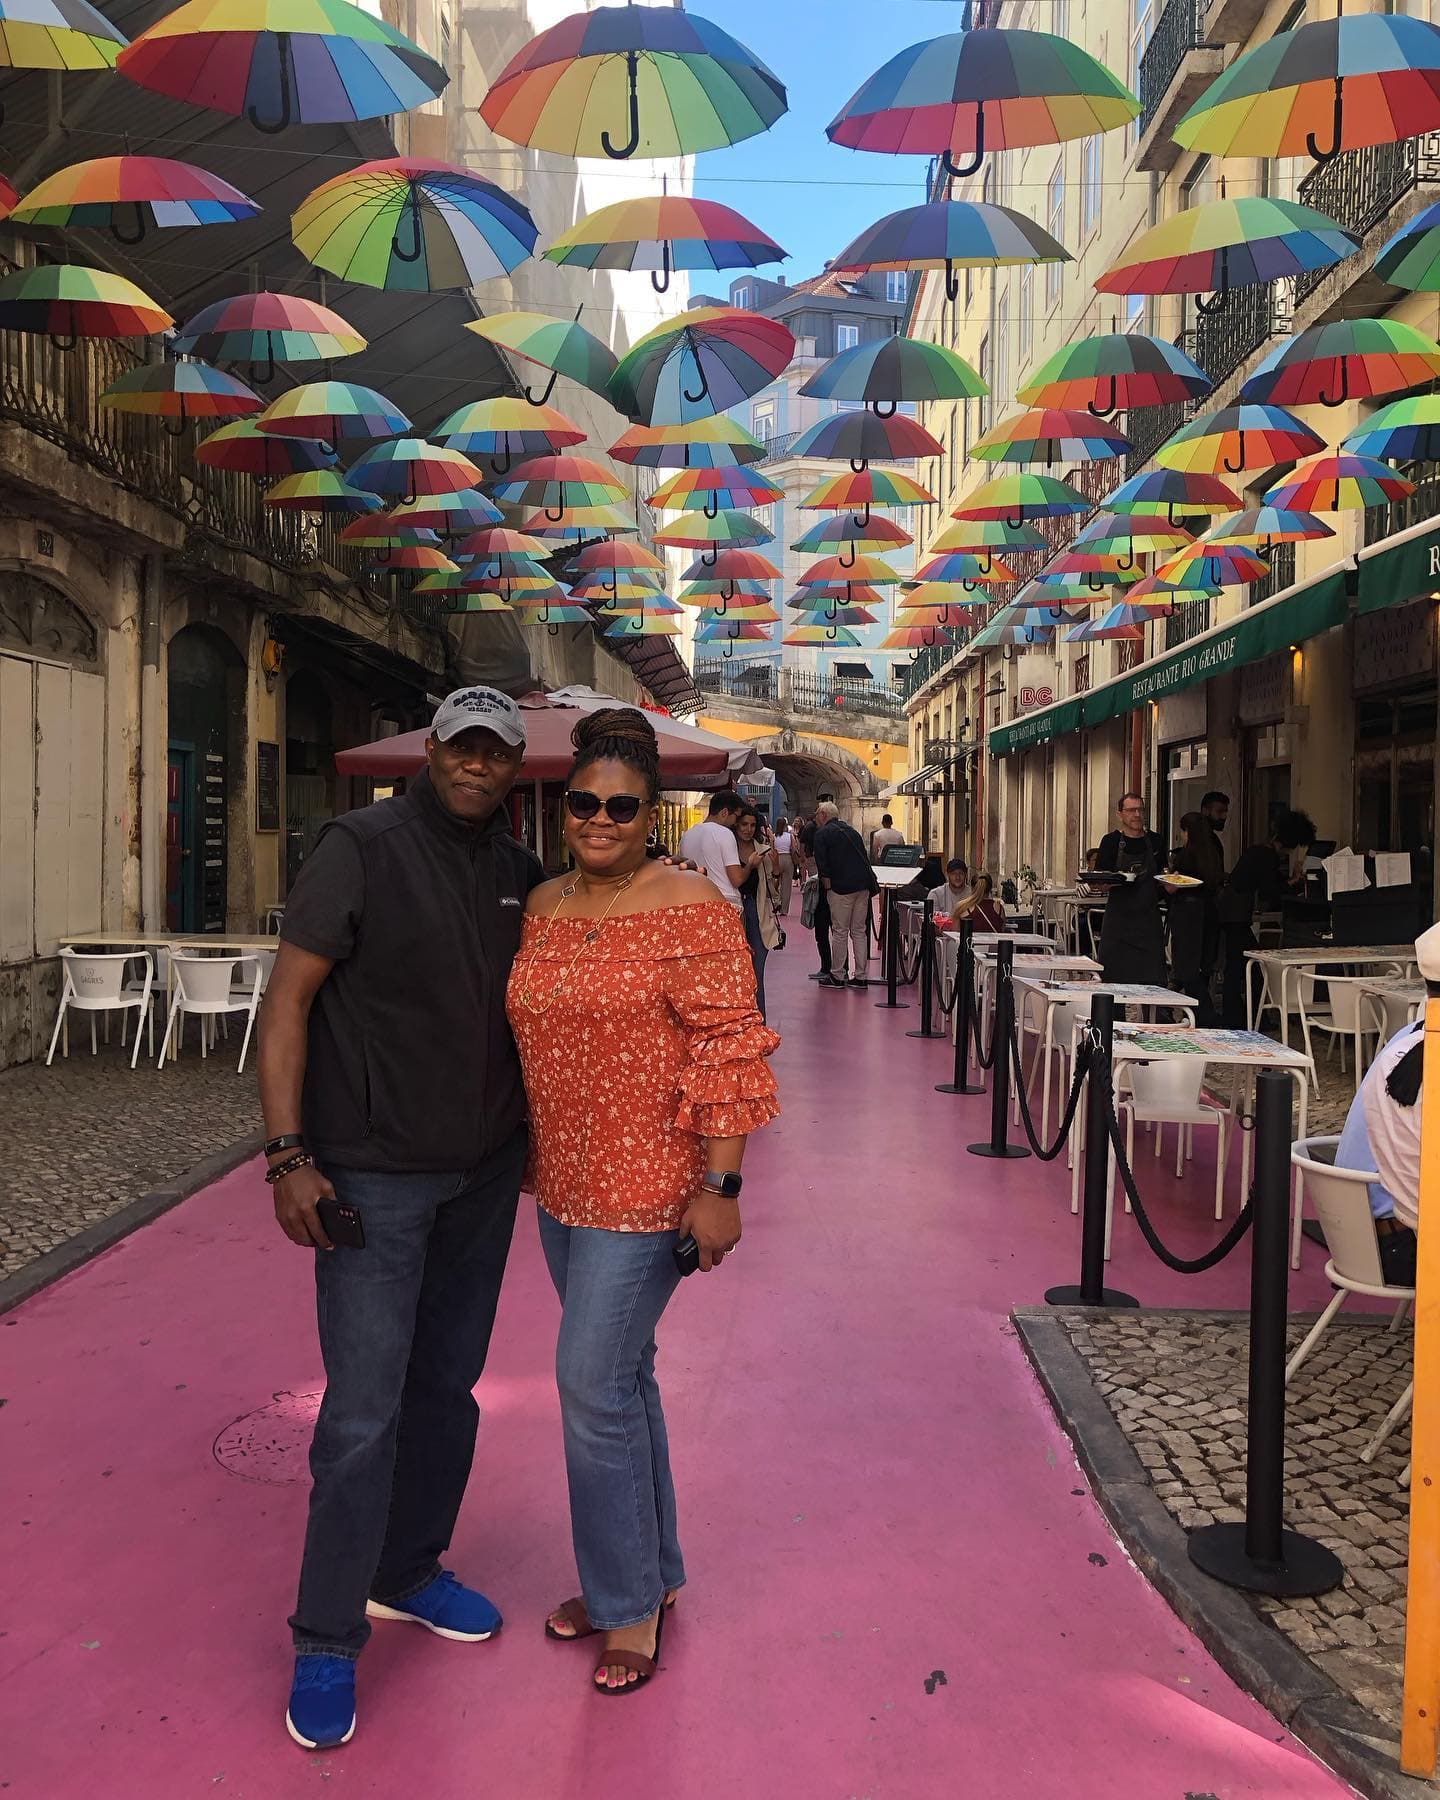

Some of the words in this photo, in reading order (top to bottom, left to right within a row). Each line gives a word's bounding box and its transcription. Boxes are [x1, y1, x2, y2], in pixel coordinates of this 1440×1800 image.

[1132, 663, 1179, 700] RESTAURANTE
[1181, 655, 1197, 679] RIO
[1199, 637, 1236, 670] GRANDE
[453, 691, 511, 712] BAHAMAS
[1020, 687, 1053, 706] BC
